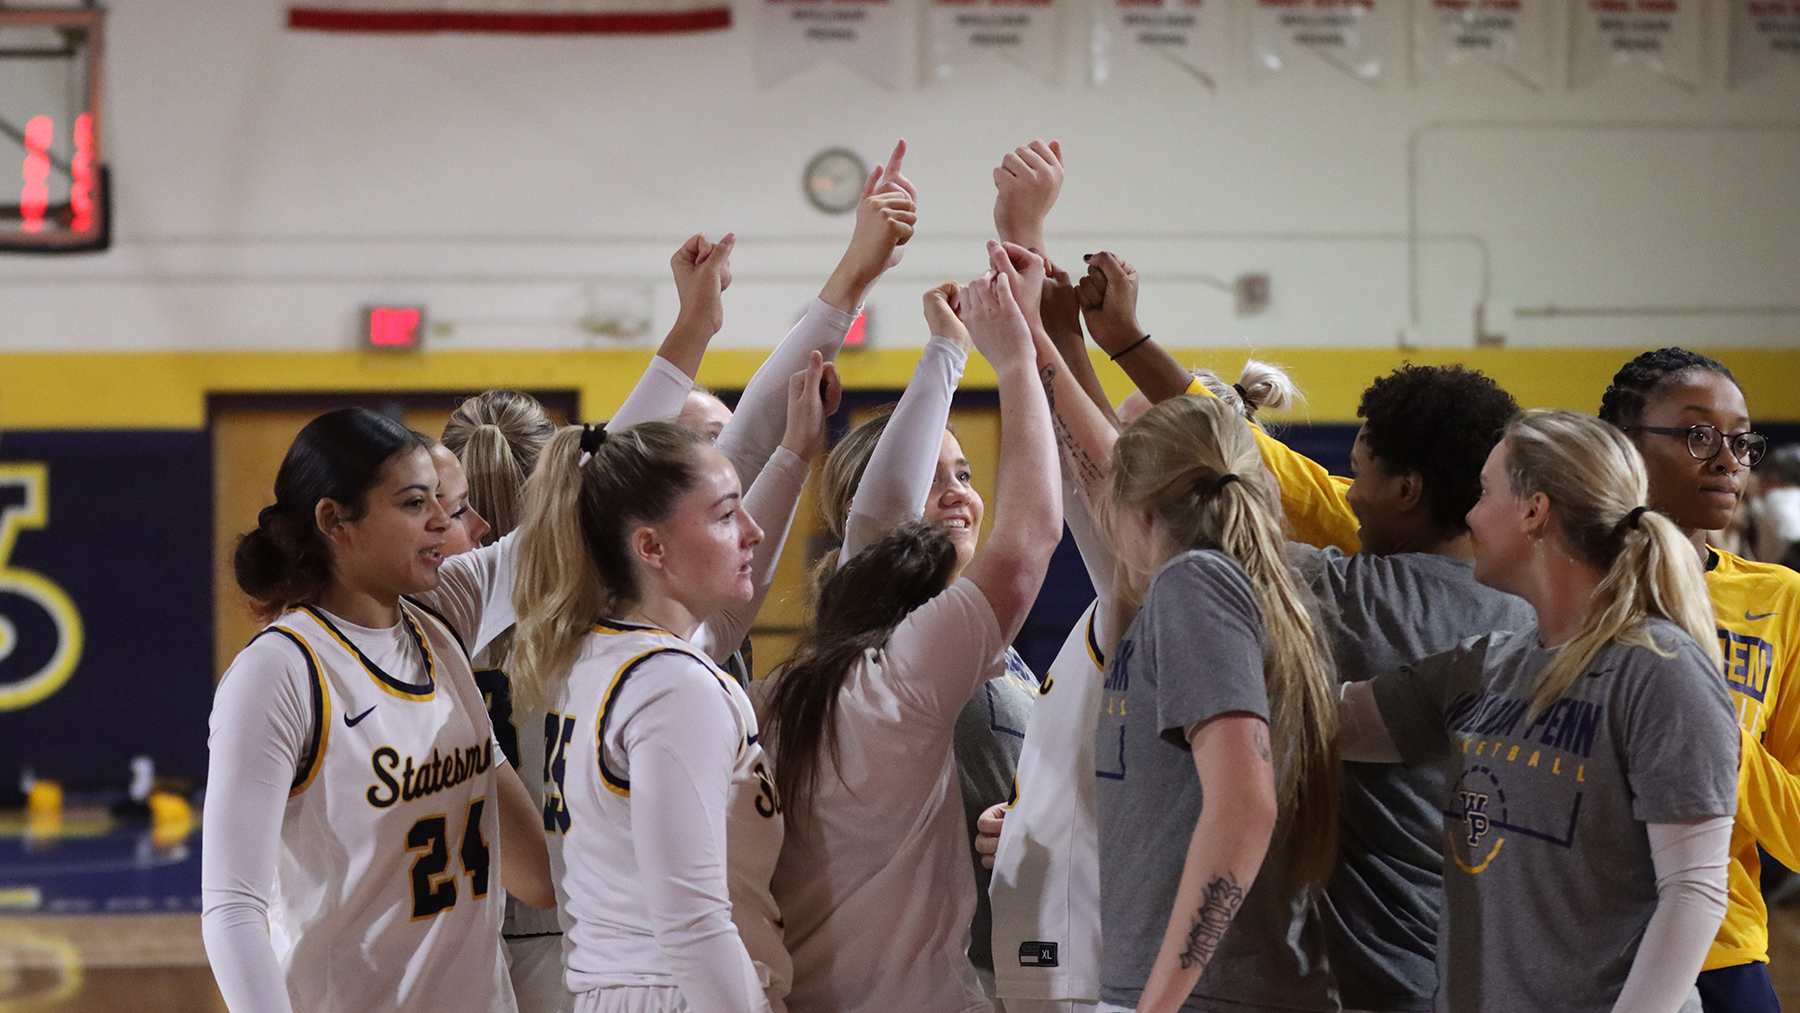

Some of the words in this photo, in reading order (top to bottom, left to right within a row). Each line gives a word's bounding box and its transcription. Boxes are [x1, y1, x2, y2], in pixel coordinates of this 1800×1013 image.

[366, 737, 491, 810] Statesm
[405, 795, 490, 922] 24
[1041, 949, 1053, 960] XL
